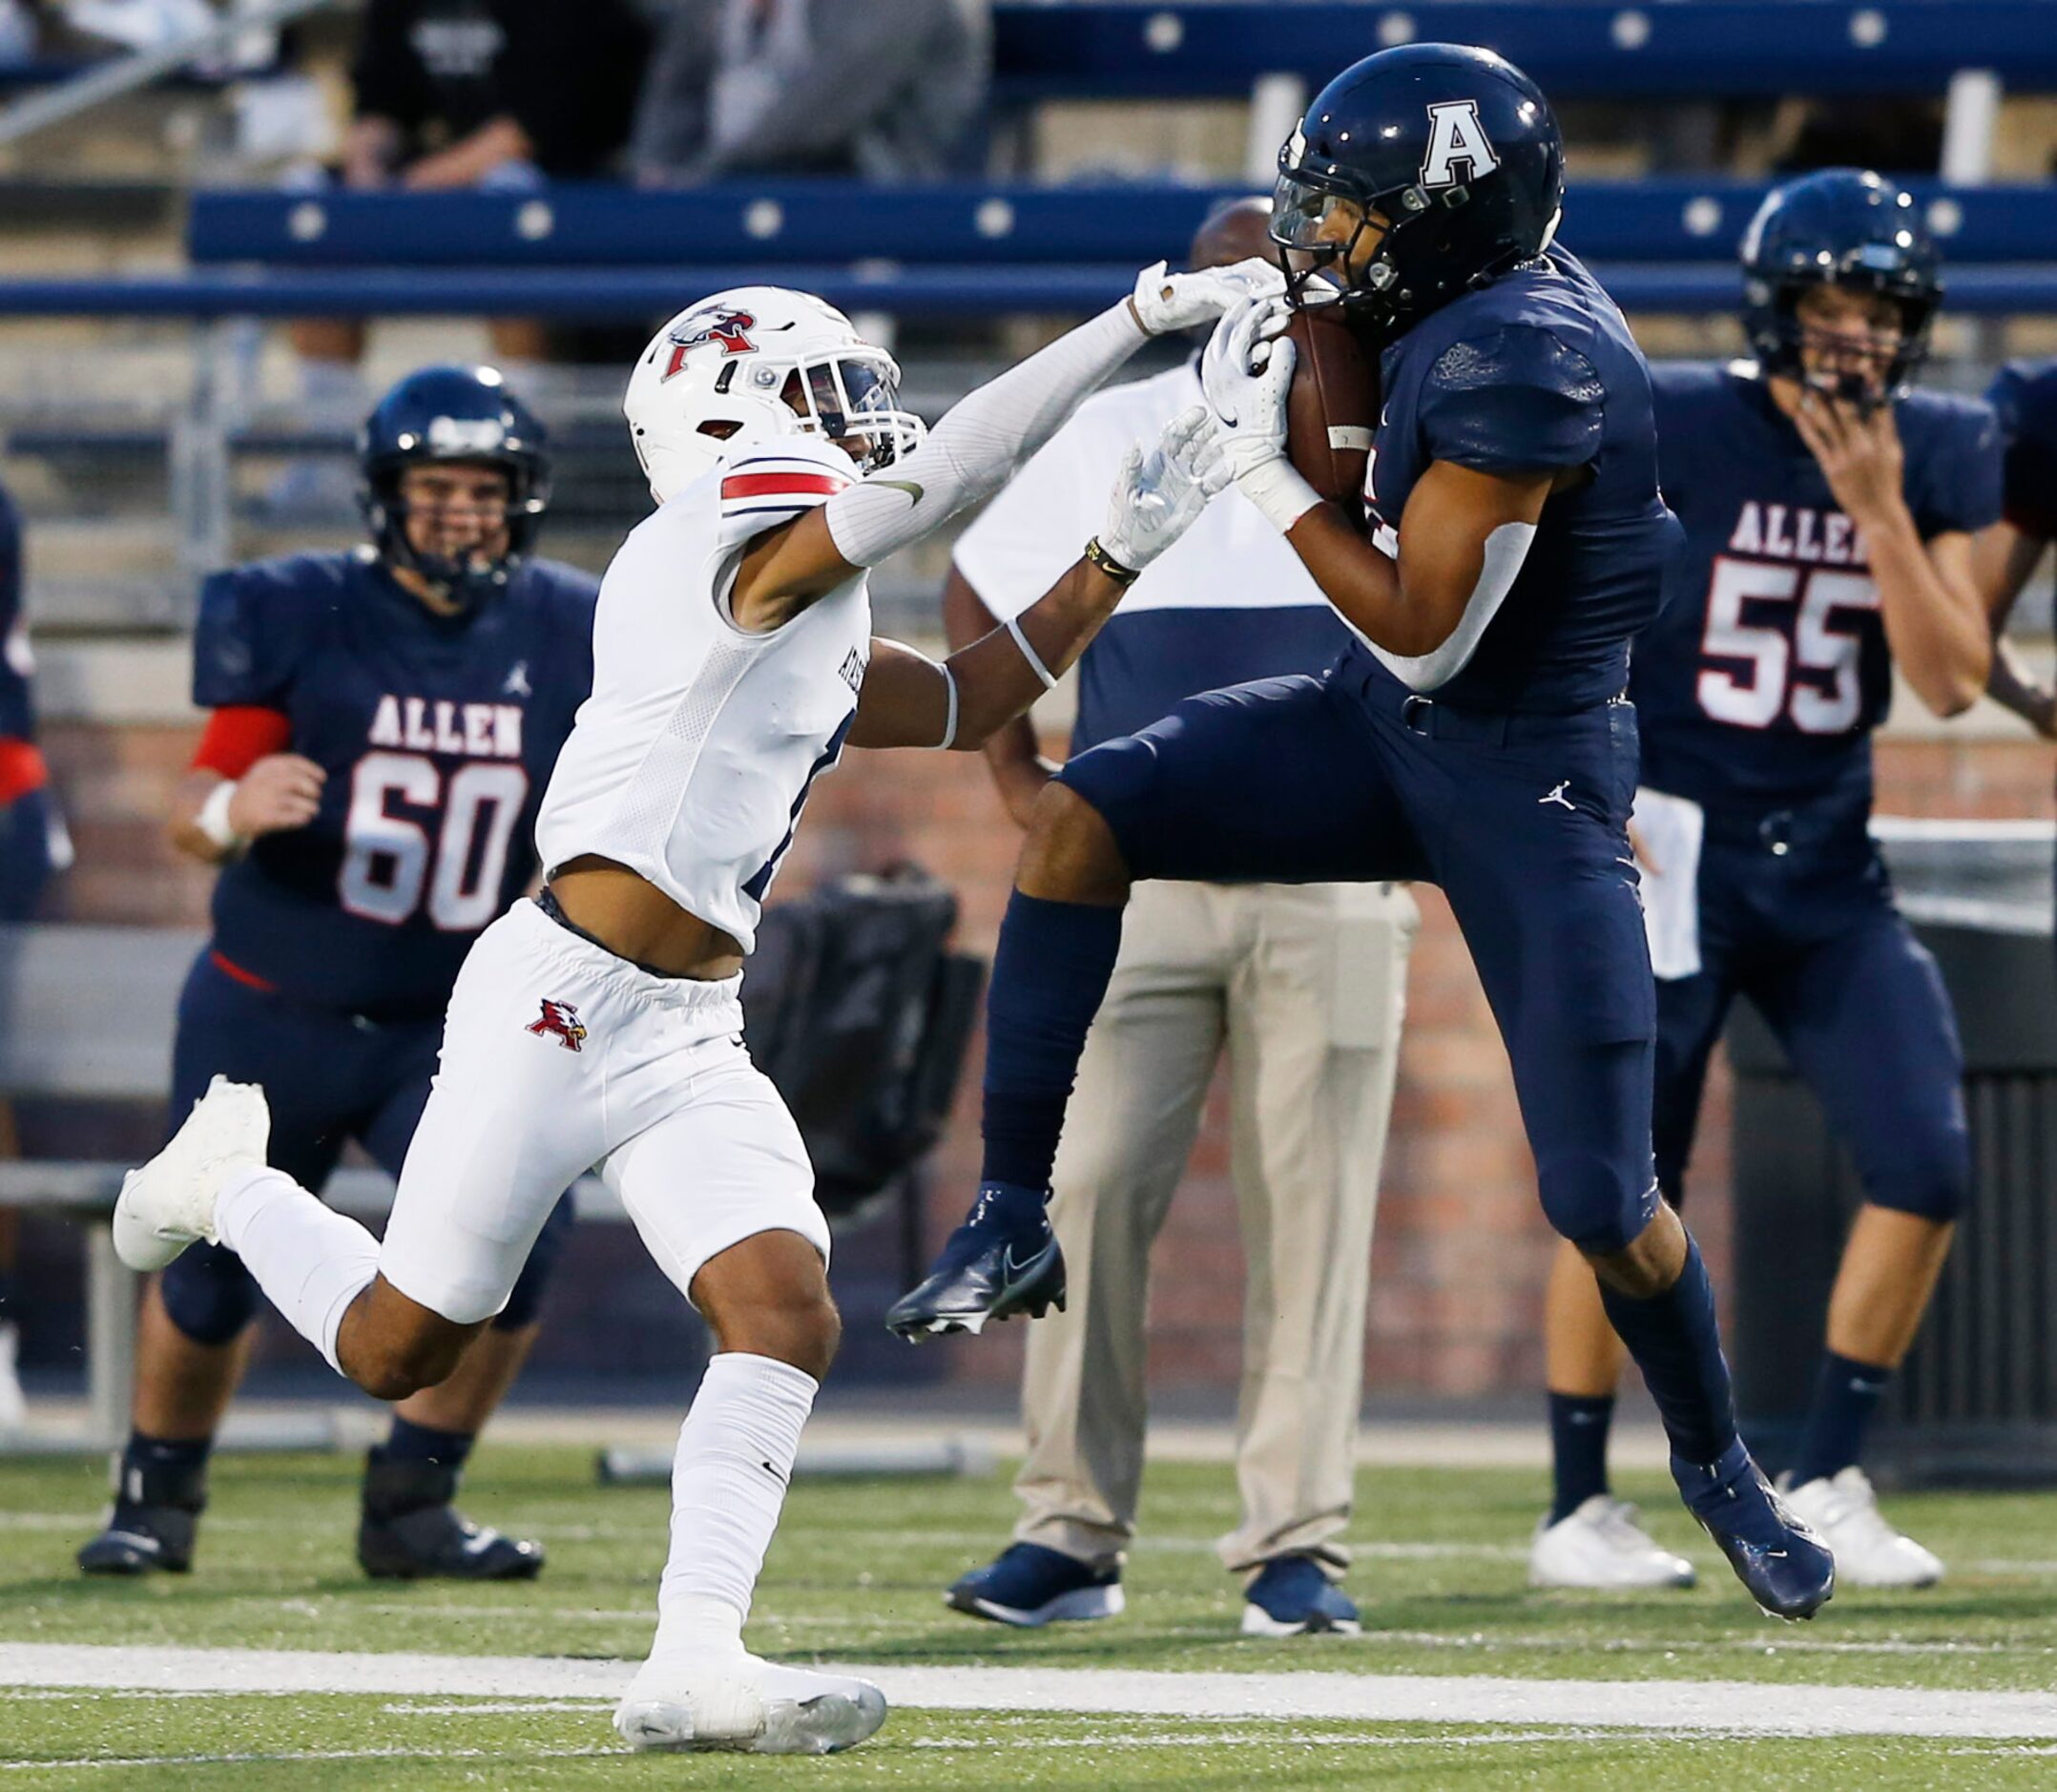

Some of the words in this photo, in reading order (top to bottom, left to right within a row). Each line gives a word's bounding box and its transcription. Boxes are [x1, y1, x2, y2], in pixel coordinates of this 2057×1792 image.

[1419, 99, 1501, 189] A
[1697, 553, 1882, 733] 55
[367, 694, 524, 758] ALLEN
[338, 749, 529, 931] 60
